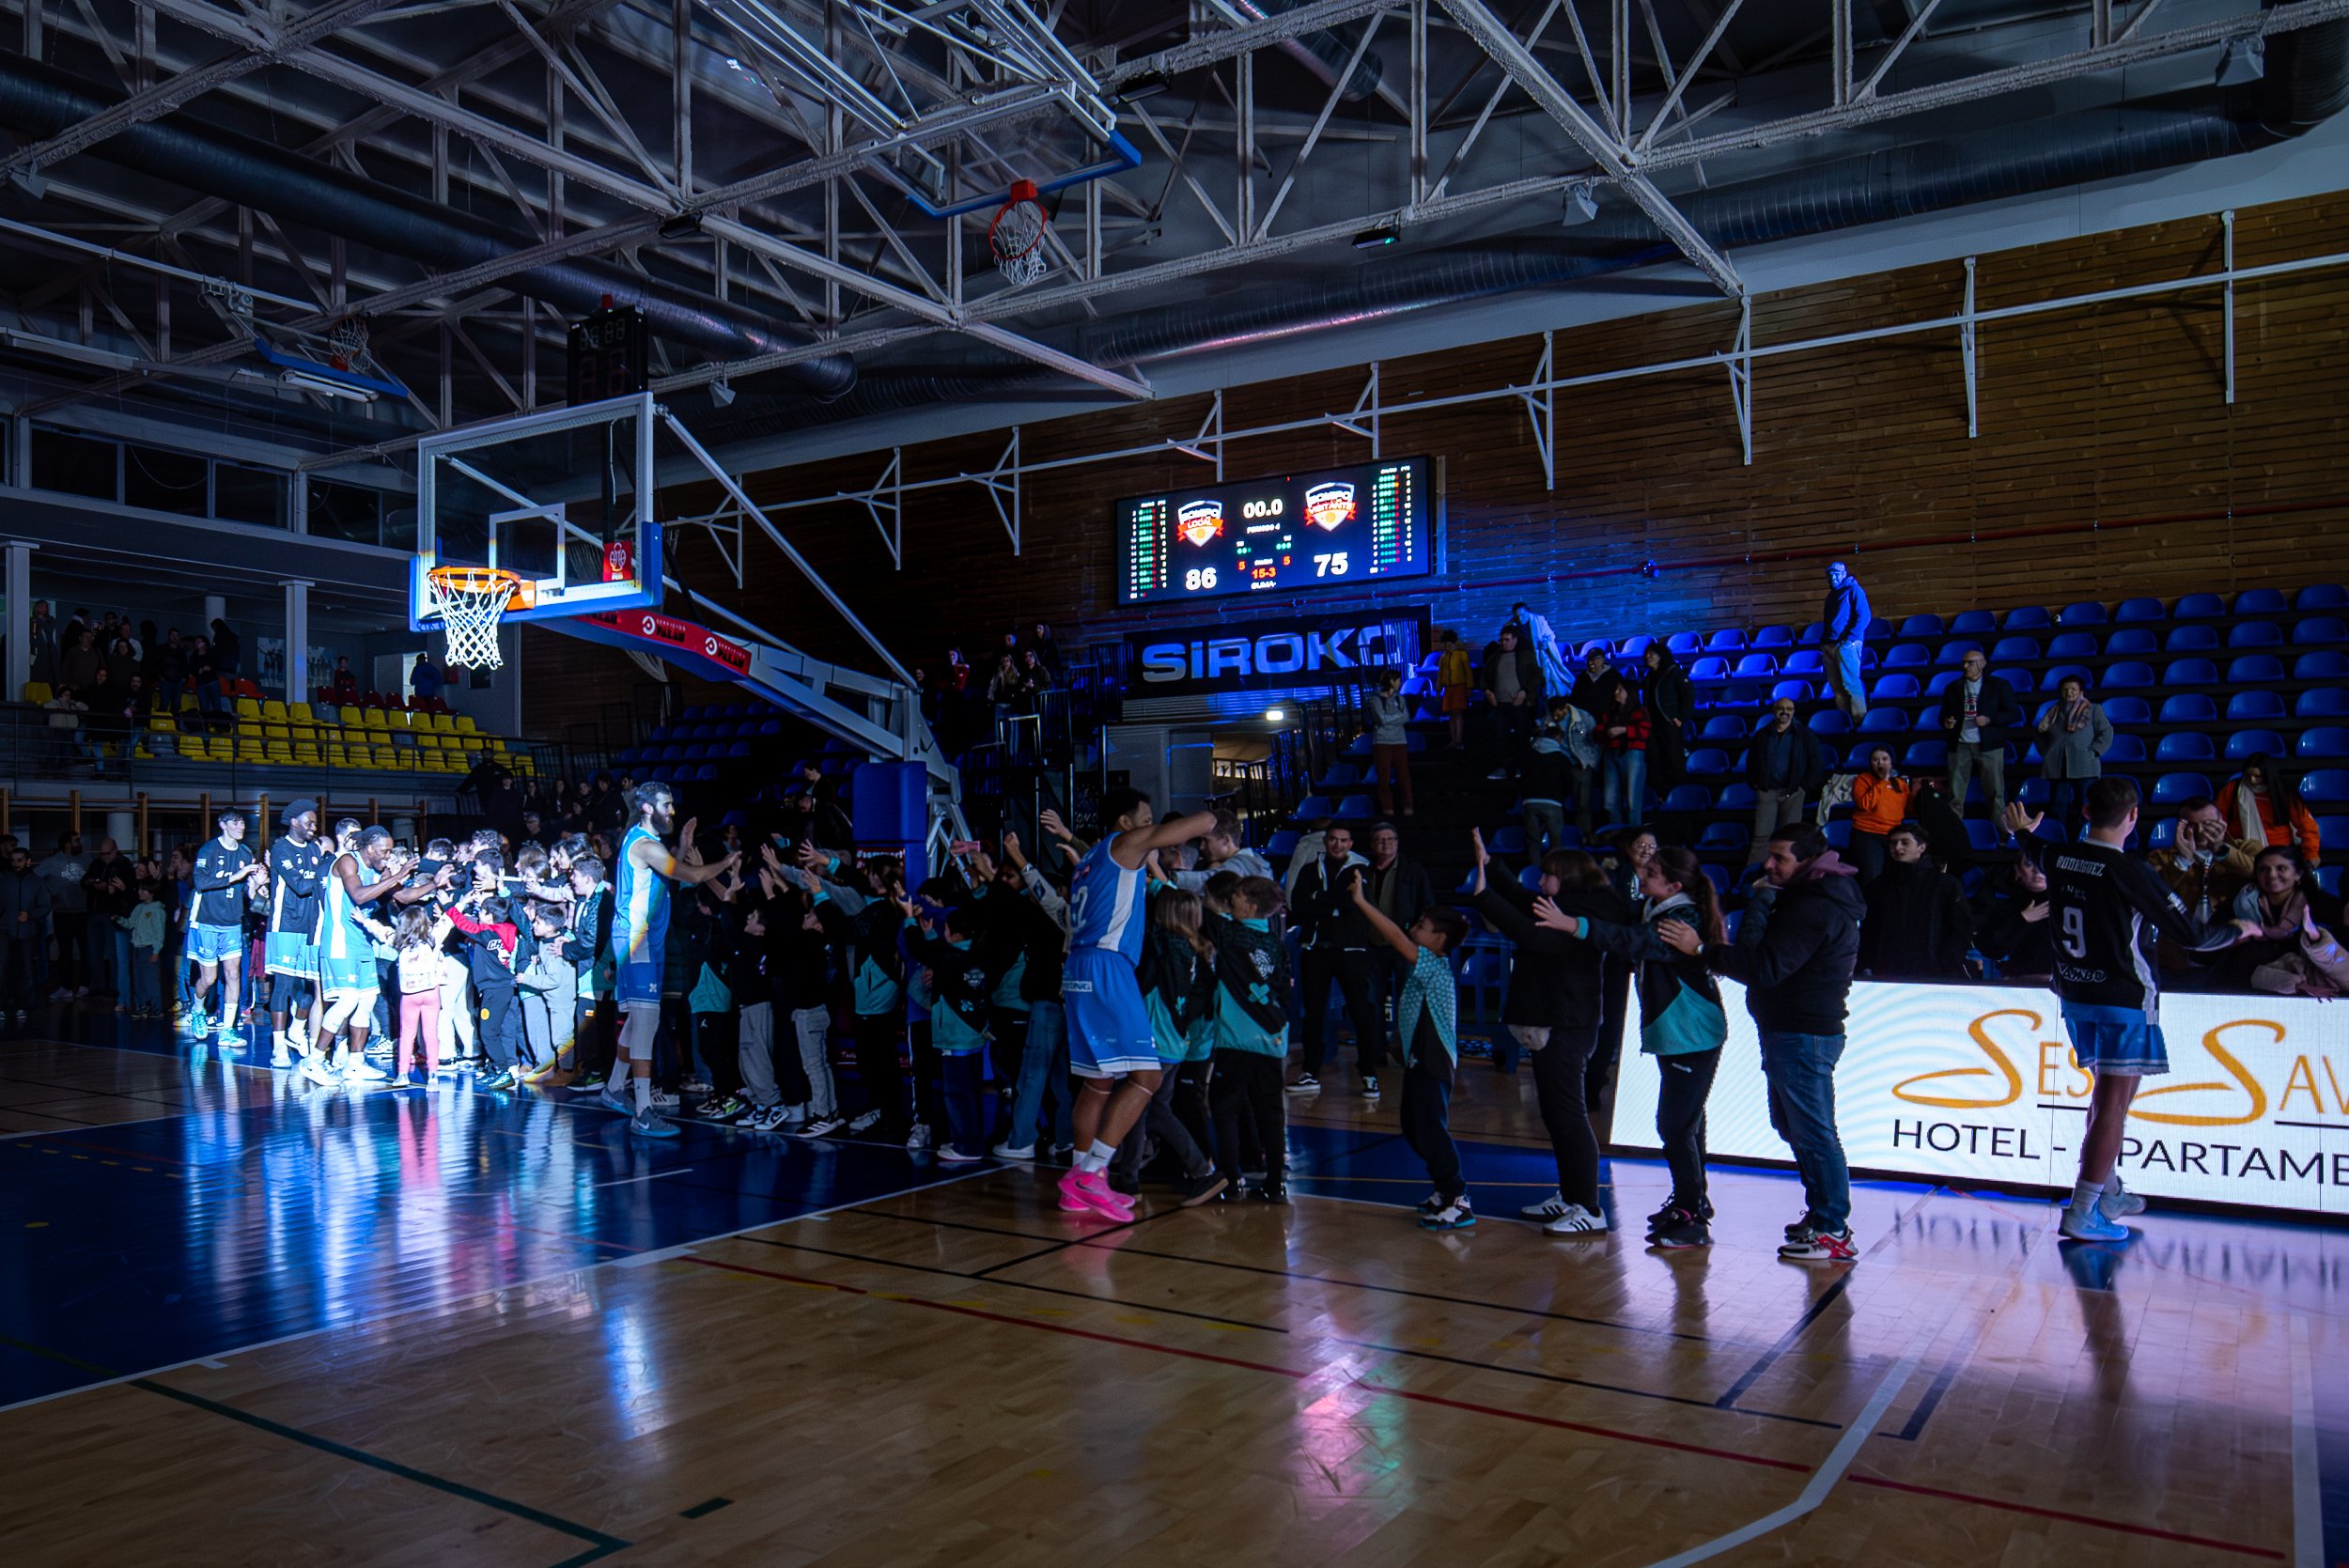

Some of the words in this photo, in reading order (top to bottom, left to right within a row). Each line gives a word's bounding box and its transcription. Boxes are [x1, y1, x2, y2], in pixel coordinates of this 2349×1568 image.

[1243, 499, 1283, 519] 00.0
[1187, 516, 1213, 529] LOCAL
[1283, 555, 1291, 566] 5
[1314, 551, 1348, 578] 75
[1185, 567, 1217, 591] 86
[2062, 906, 2087, 958] 9
[1892, 1119, 2041, 1159] HOTEL
[2116, 1136, 2349, 1187] PARTAME
